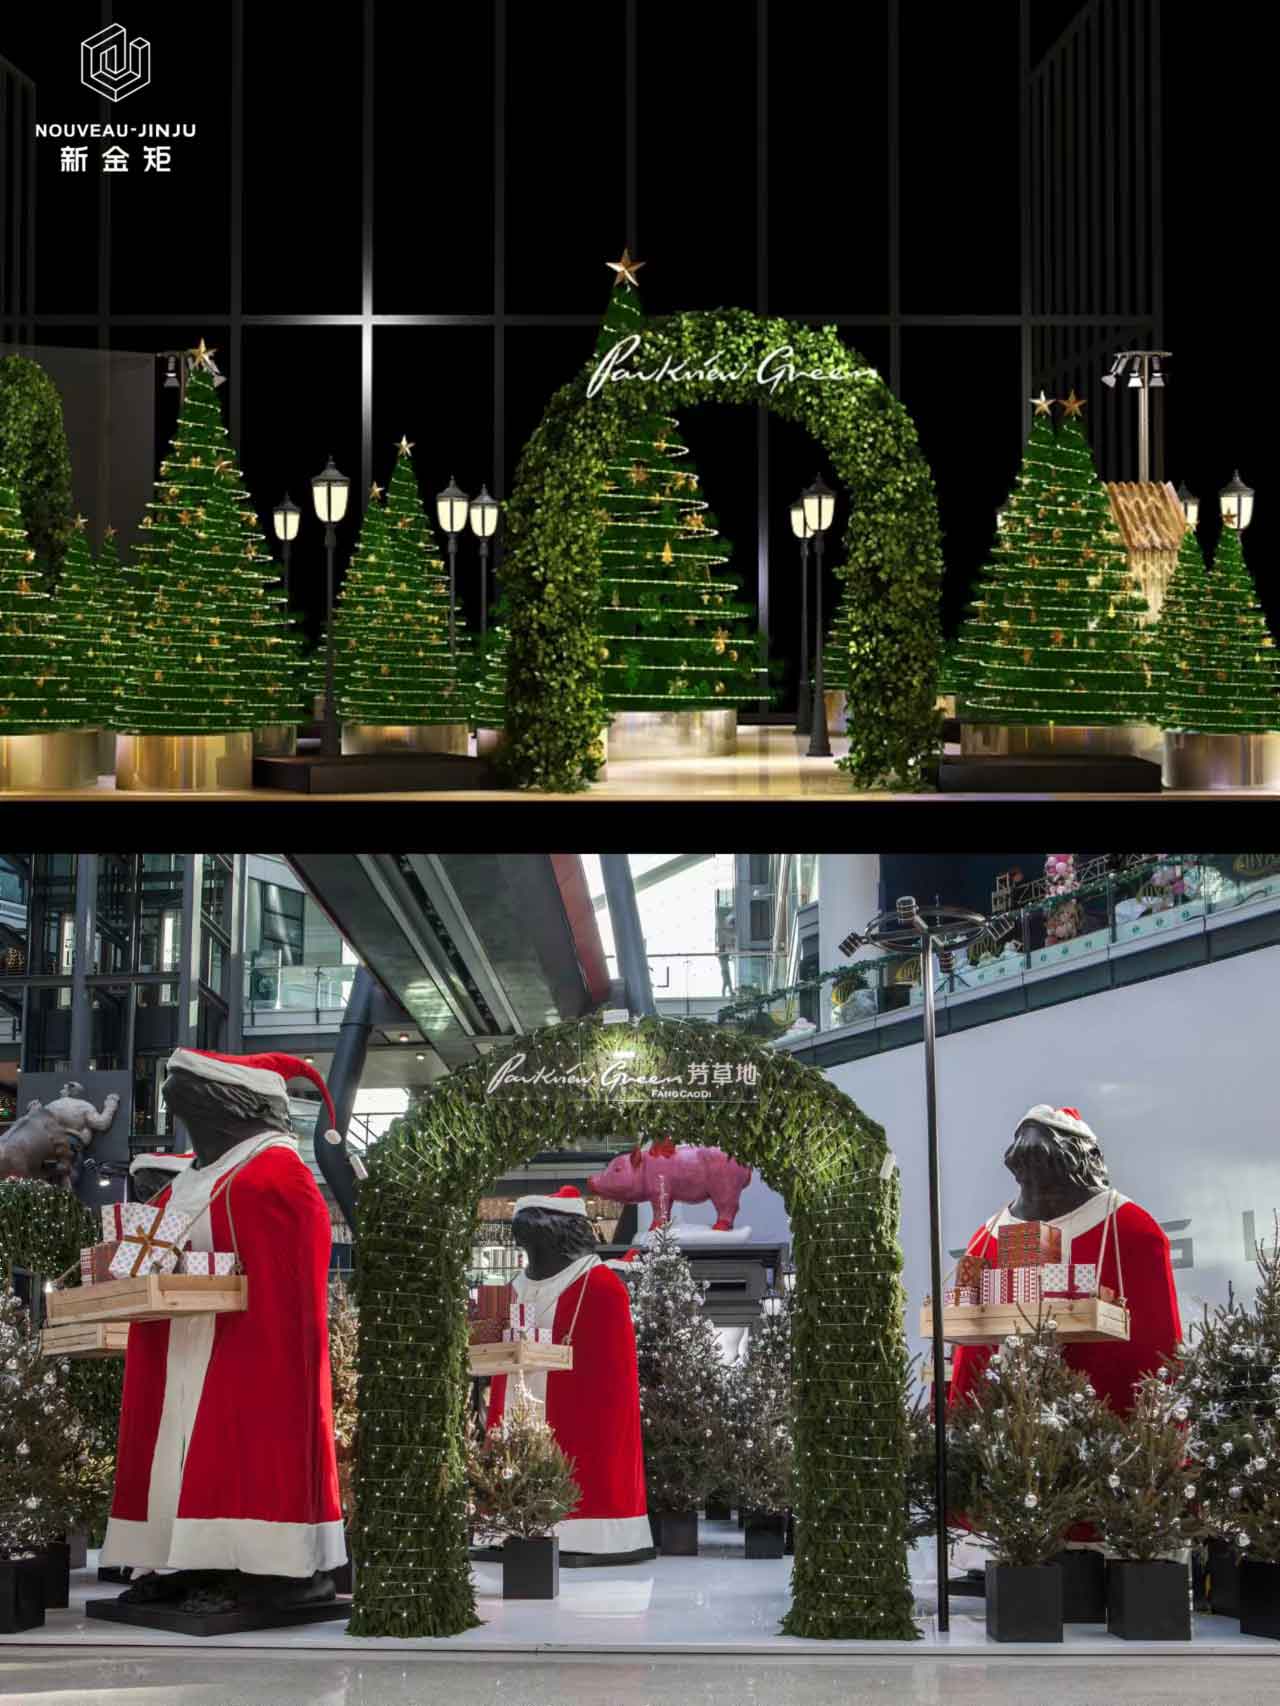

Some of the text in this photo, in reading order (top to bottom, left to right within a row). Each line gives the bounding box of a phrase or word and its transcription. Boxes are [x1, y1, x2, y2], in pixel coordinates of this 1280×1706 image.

[756, 346, 878, 394] Green
[600, 1060, 683, 1093] Green
[687, 1061, 758, 1087] 芳草地
